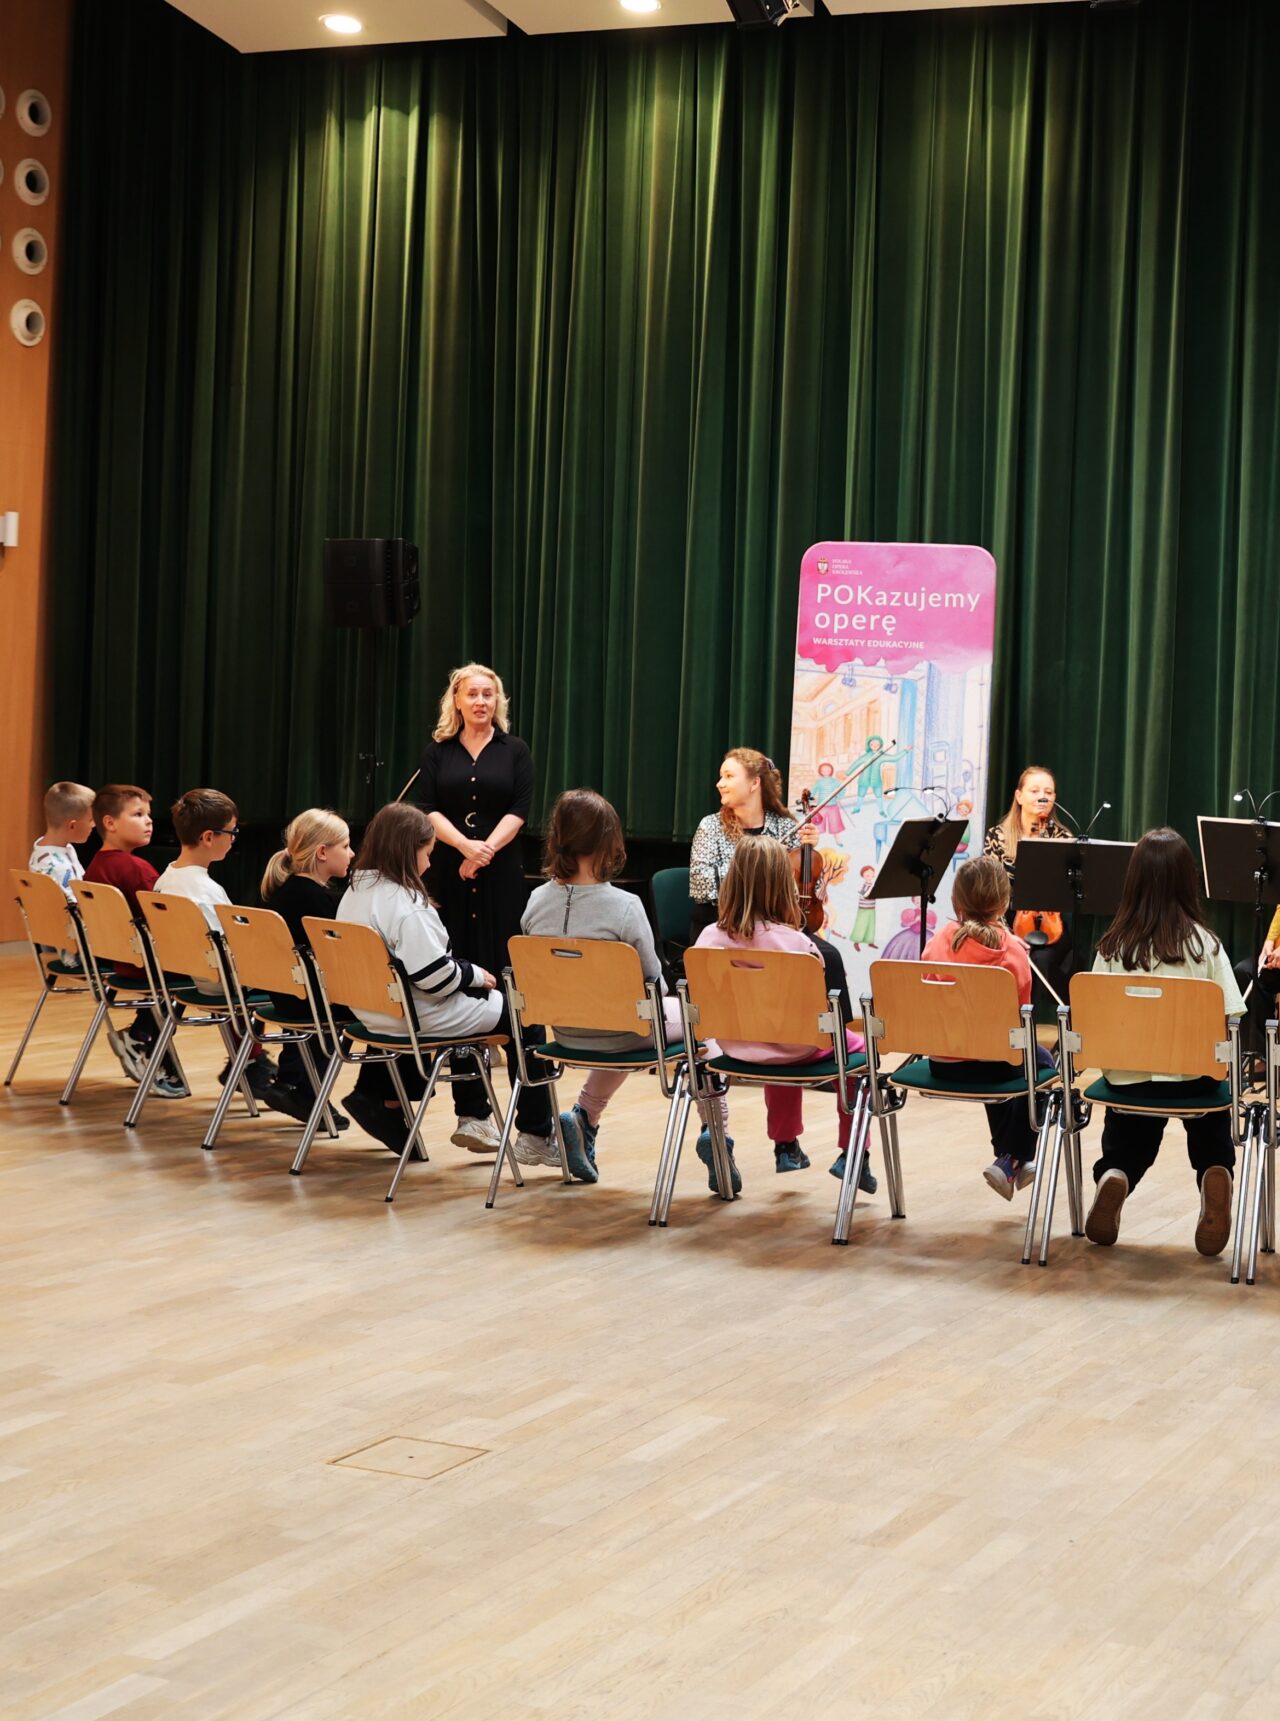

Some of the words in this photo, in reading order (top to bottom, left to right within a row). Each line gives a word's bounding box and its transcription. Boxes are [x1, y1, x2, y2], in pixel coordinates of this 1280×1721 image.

[816, 583, 981, 612] POKazujemy
[814, 612, 897, 636] operę
[813, 637, 865, 648] WARSZTATY
[867, 639, 925, 649] EDUKACYJNE
